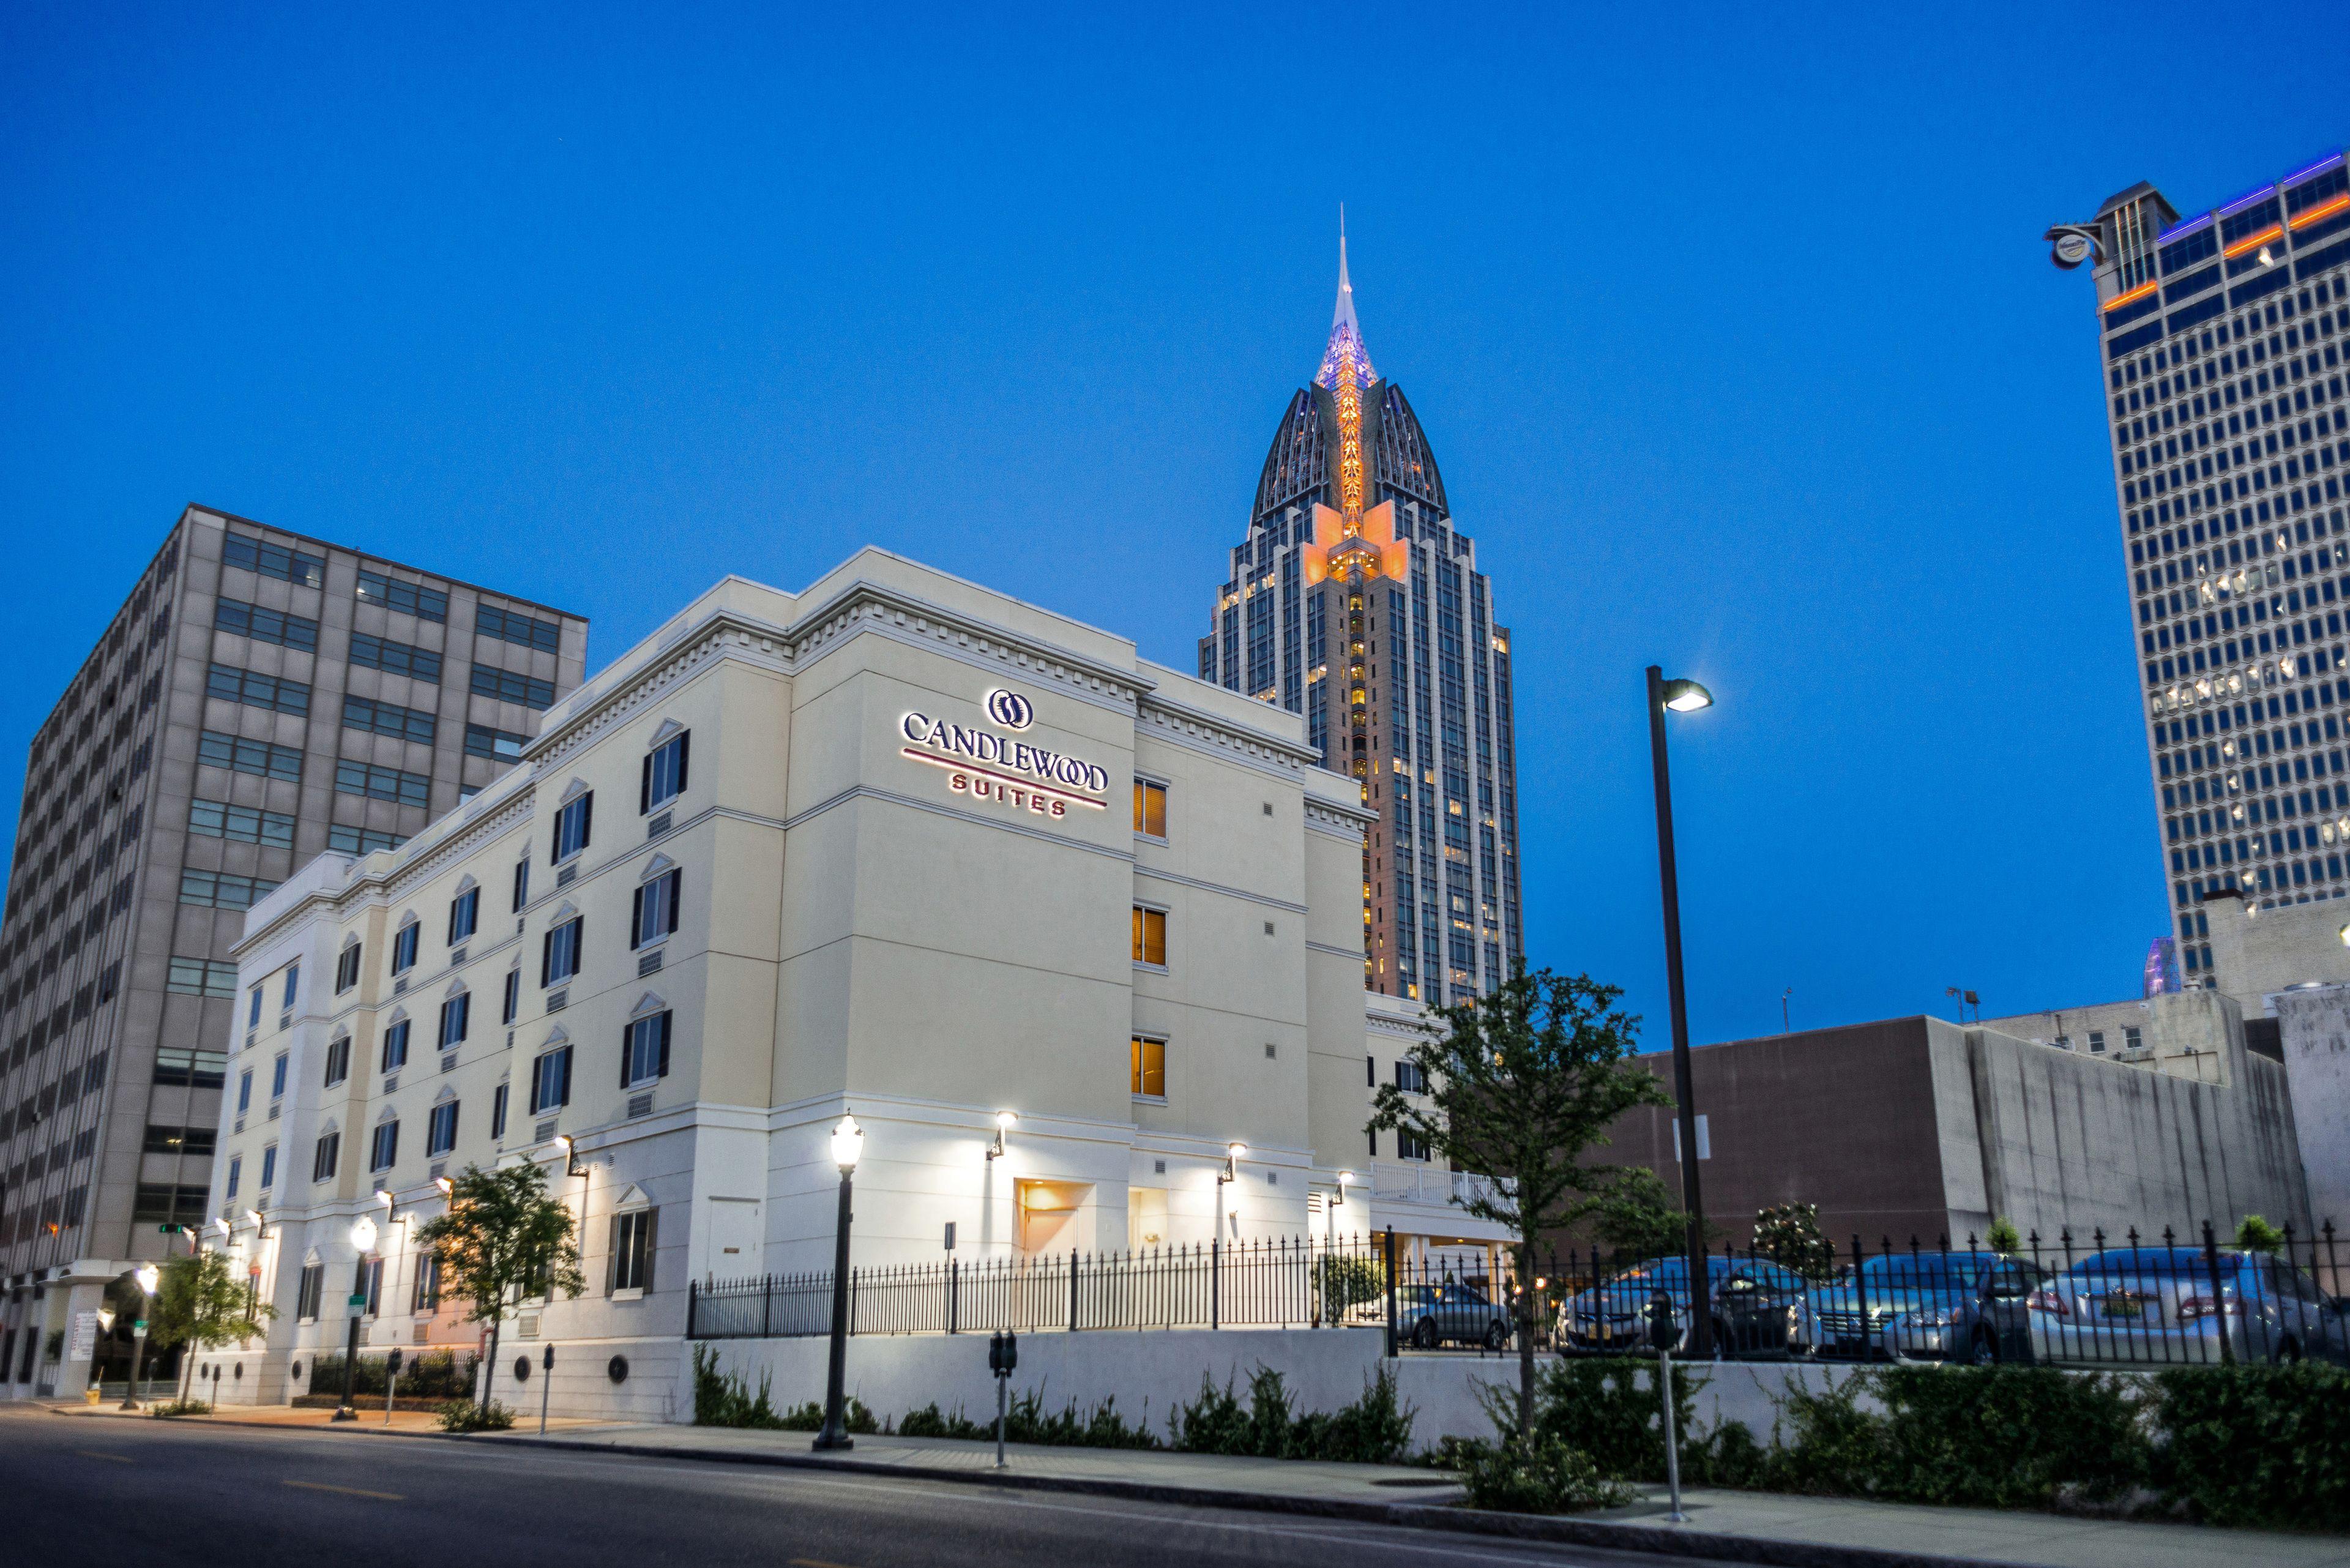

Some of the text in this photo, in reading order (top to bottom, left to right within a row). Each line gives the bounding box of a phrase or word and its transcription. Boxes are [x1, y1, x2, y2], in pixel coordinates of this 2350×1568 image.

[904, 712, 1108, 791] CANDLEWOOD
[952, 774, 1065, 815] SUITES
[72, 1316, 81, 1351] AVAILABLE
